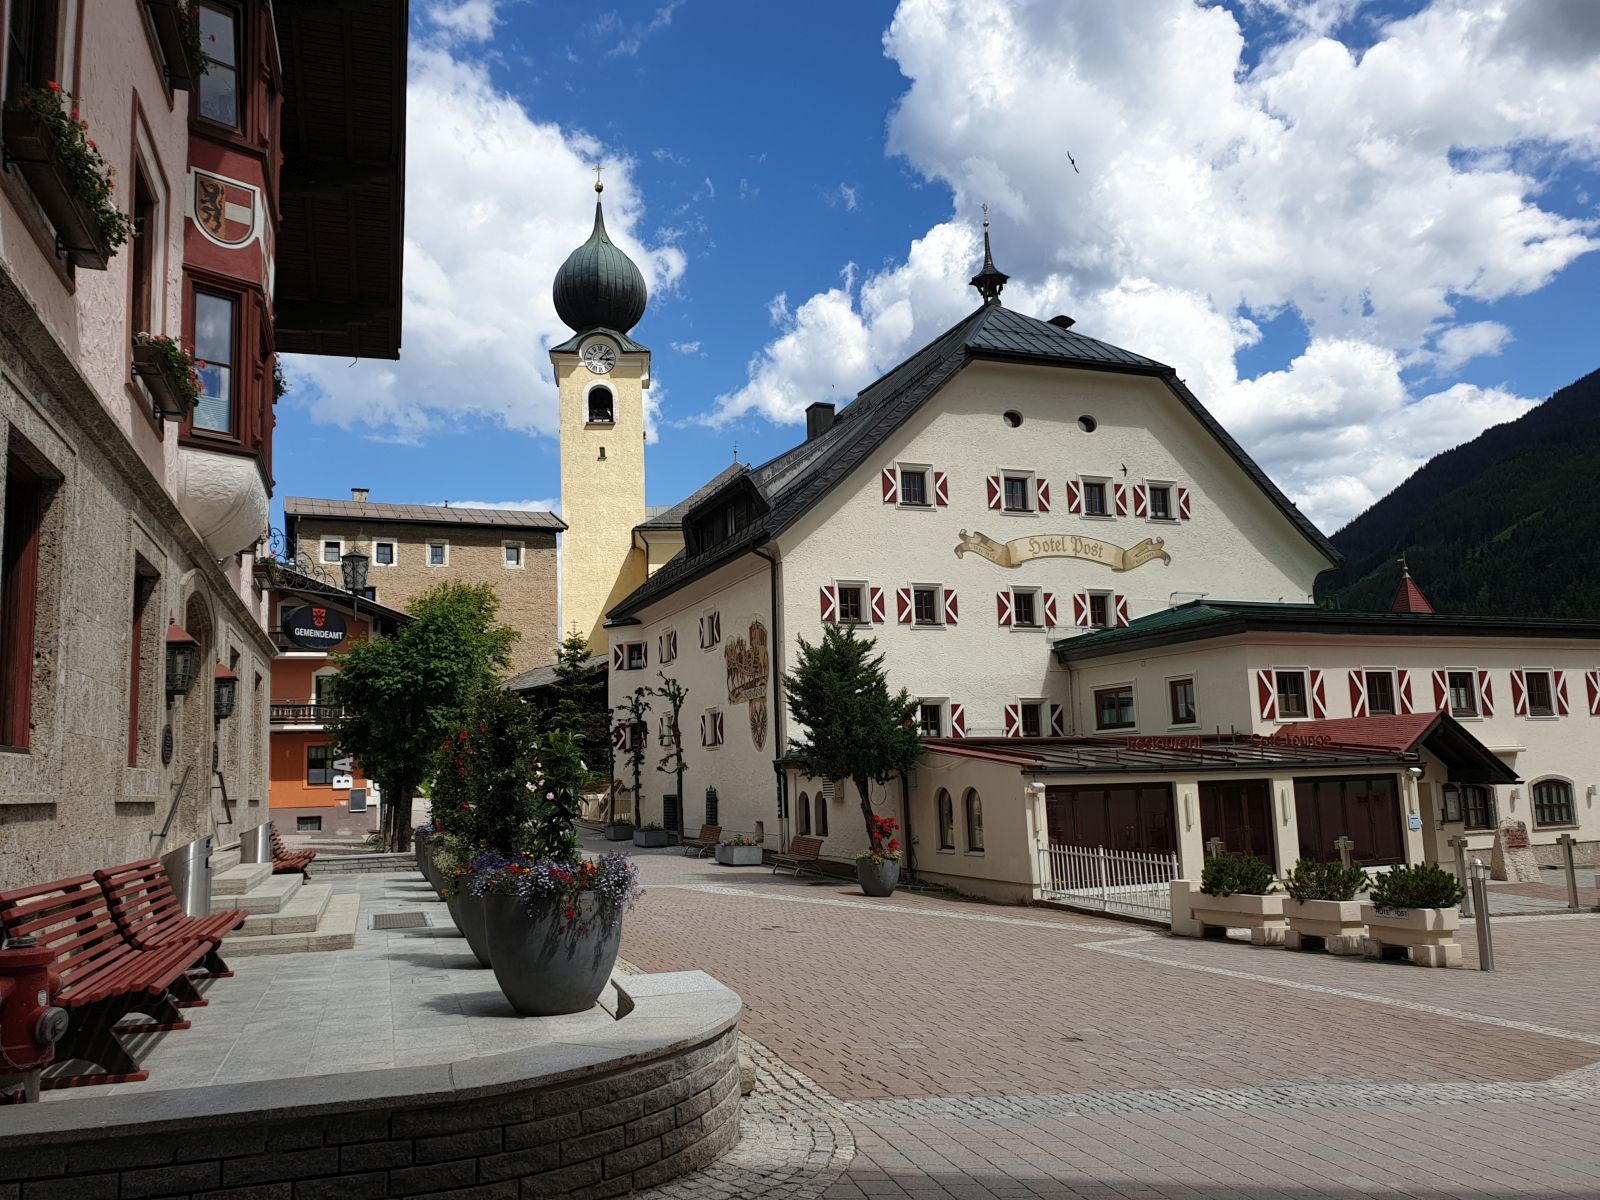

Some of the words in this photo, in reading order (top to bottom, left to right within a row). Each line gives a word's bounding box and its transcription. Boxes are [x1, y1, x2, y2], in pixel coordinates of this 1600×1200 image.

[1028, 537, 1067, 557] Hotel
[1071, 536, 1104, 558] Post
[294, 627, 344, 640] GEMEINDEAMT
